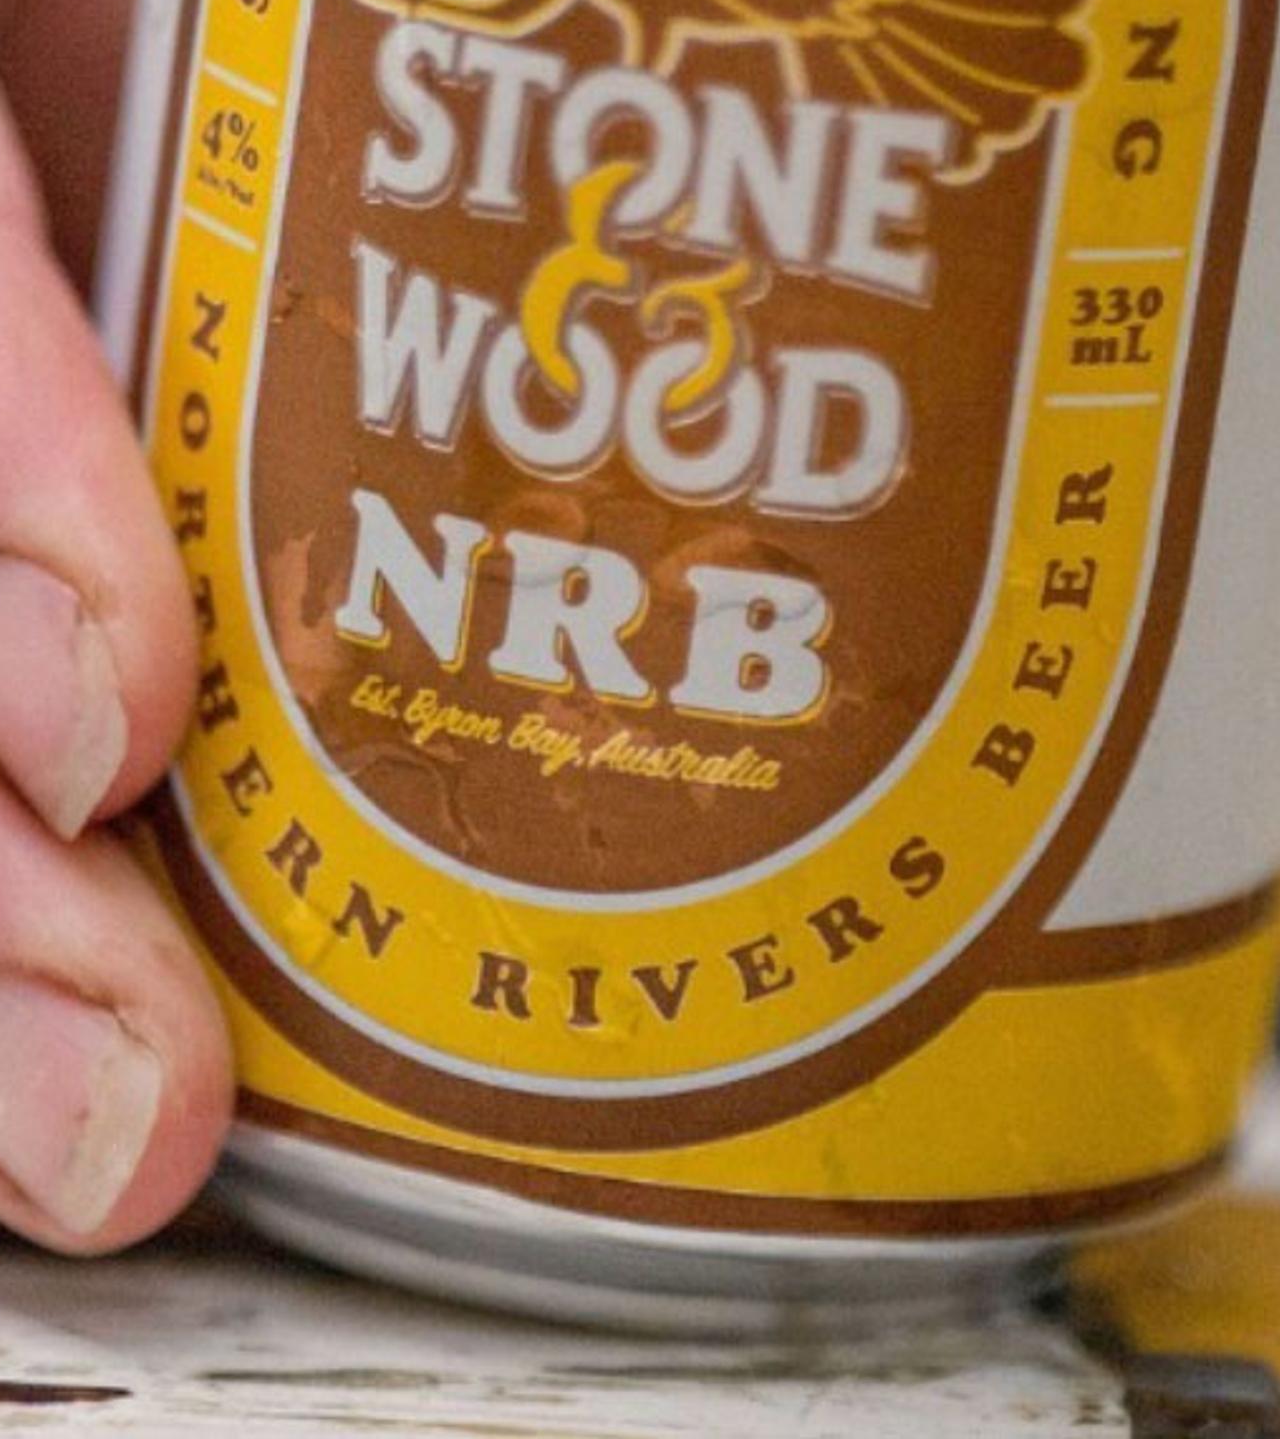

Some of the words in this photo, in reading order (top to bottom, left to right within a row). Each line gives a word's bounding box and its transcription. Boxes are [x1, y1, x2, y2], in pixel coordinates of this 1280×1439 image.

[201, 111, 260, 172] 4%
[362, 18, 952, 306] STONE
[352, 238, 908, 520] WOOD
[1070, 286, 1163, 326] 330
[1070, 323, 1153, 365] mL
[334, 486, 834, 726] NRB
[349, 673, 400, 720] Est.
[404, 687, 501, 746] Byron
[507, 710, 584, 777] Bay,
[587, 728, 783, 792] Australia
[470, 834, 948, 1029] RIVERS
[970, 462, 1113, 788] BEER
